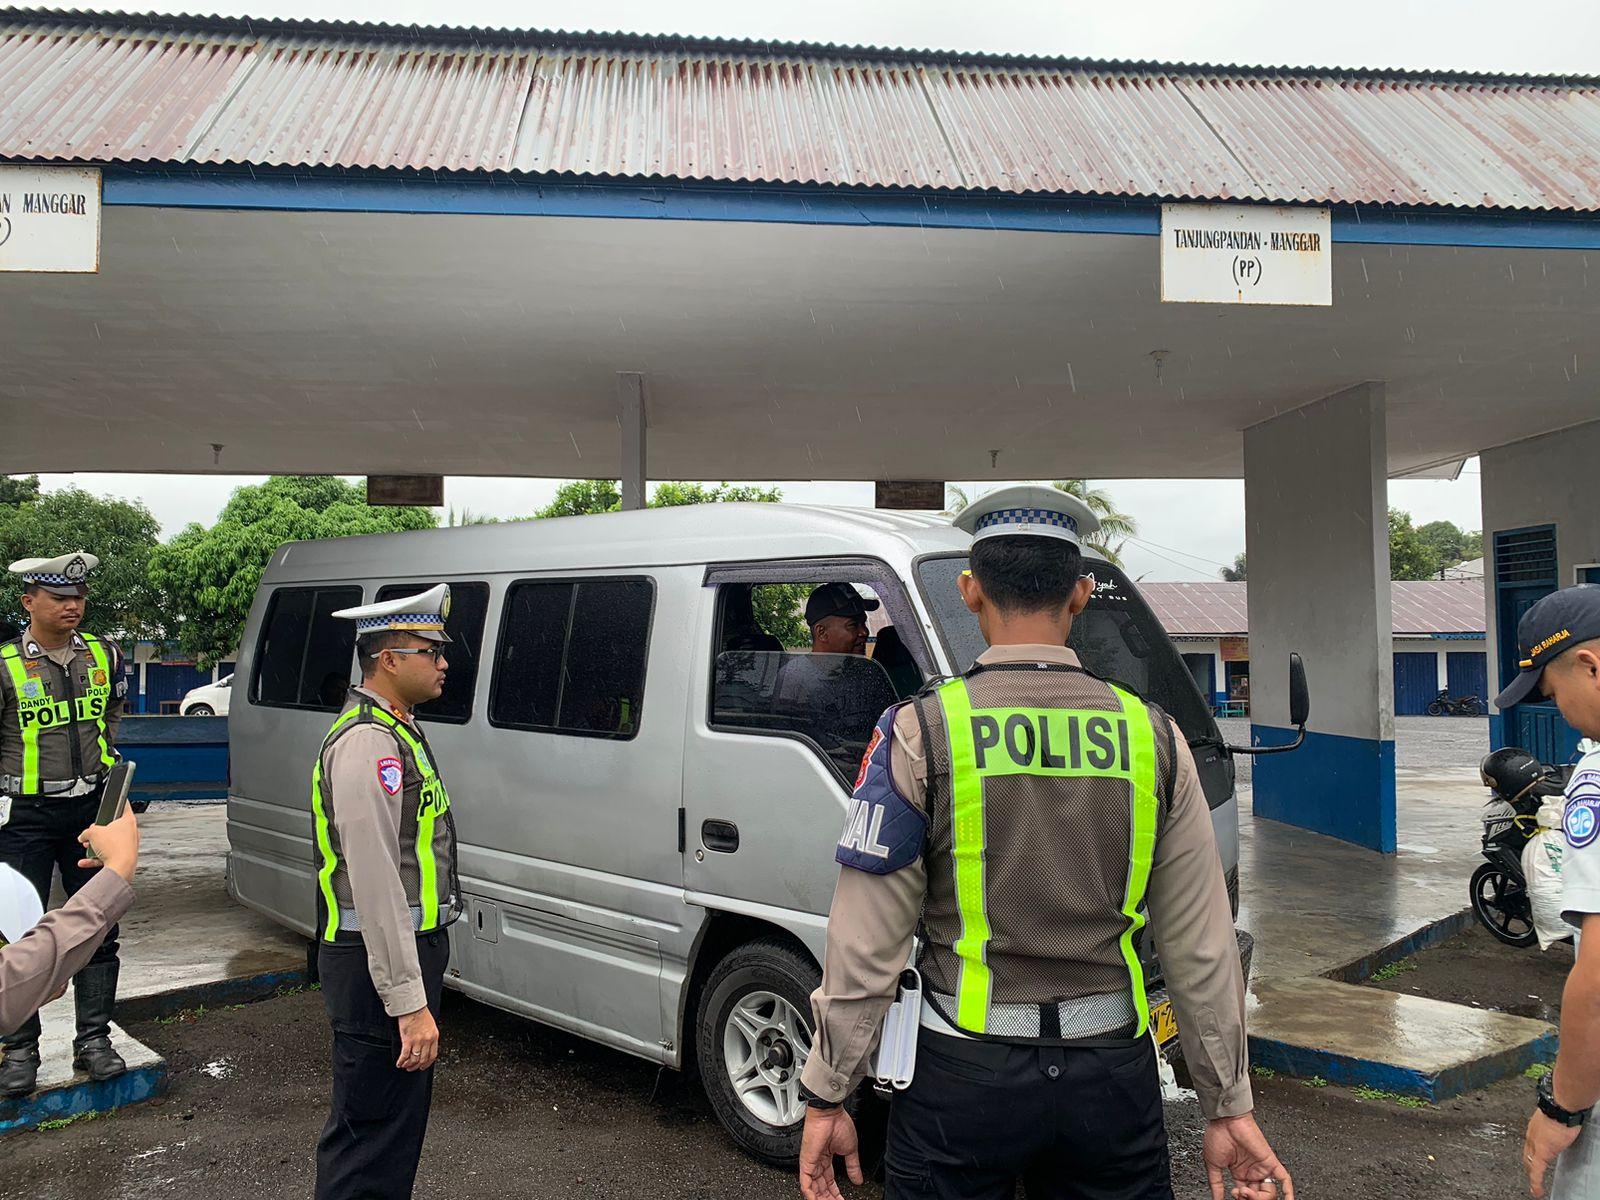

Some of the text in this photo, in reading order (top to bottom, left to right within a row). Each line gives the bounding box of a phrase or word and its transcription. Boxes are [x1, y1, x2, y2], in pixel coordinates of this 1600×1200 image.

[23, 193, 86, 215] MANGGAR
[1174, 229, 1261, 250] TANJUNGPANDAN
[1271, 232, 1321, 251] MANGGAR
[1232, 255, 1262, 286] (PP)
[20, 697, 52, 710] DANDY
[971, 714, 1130, 770] POLISI
